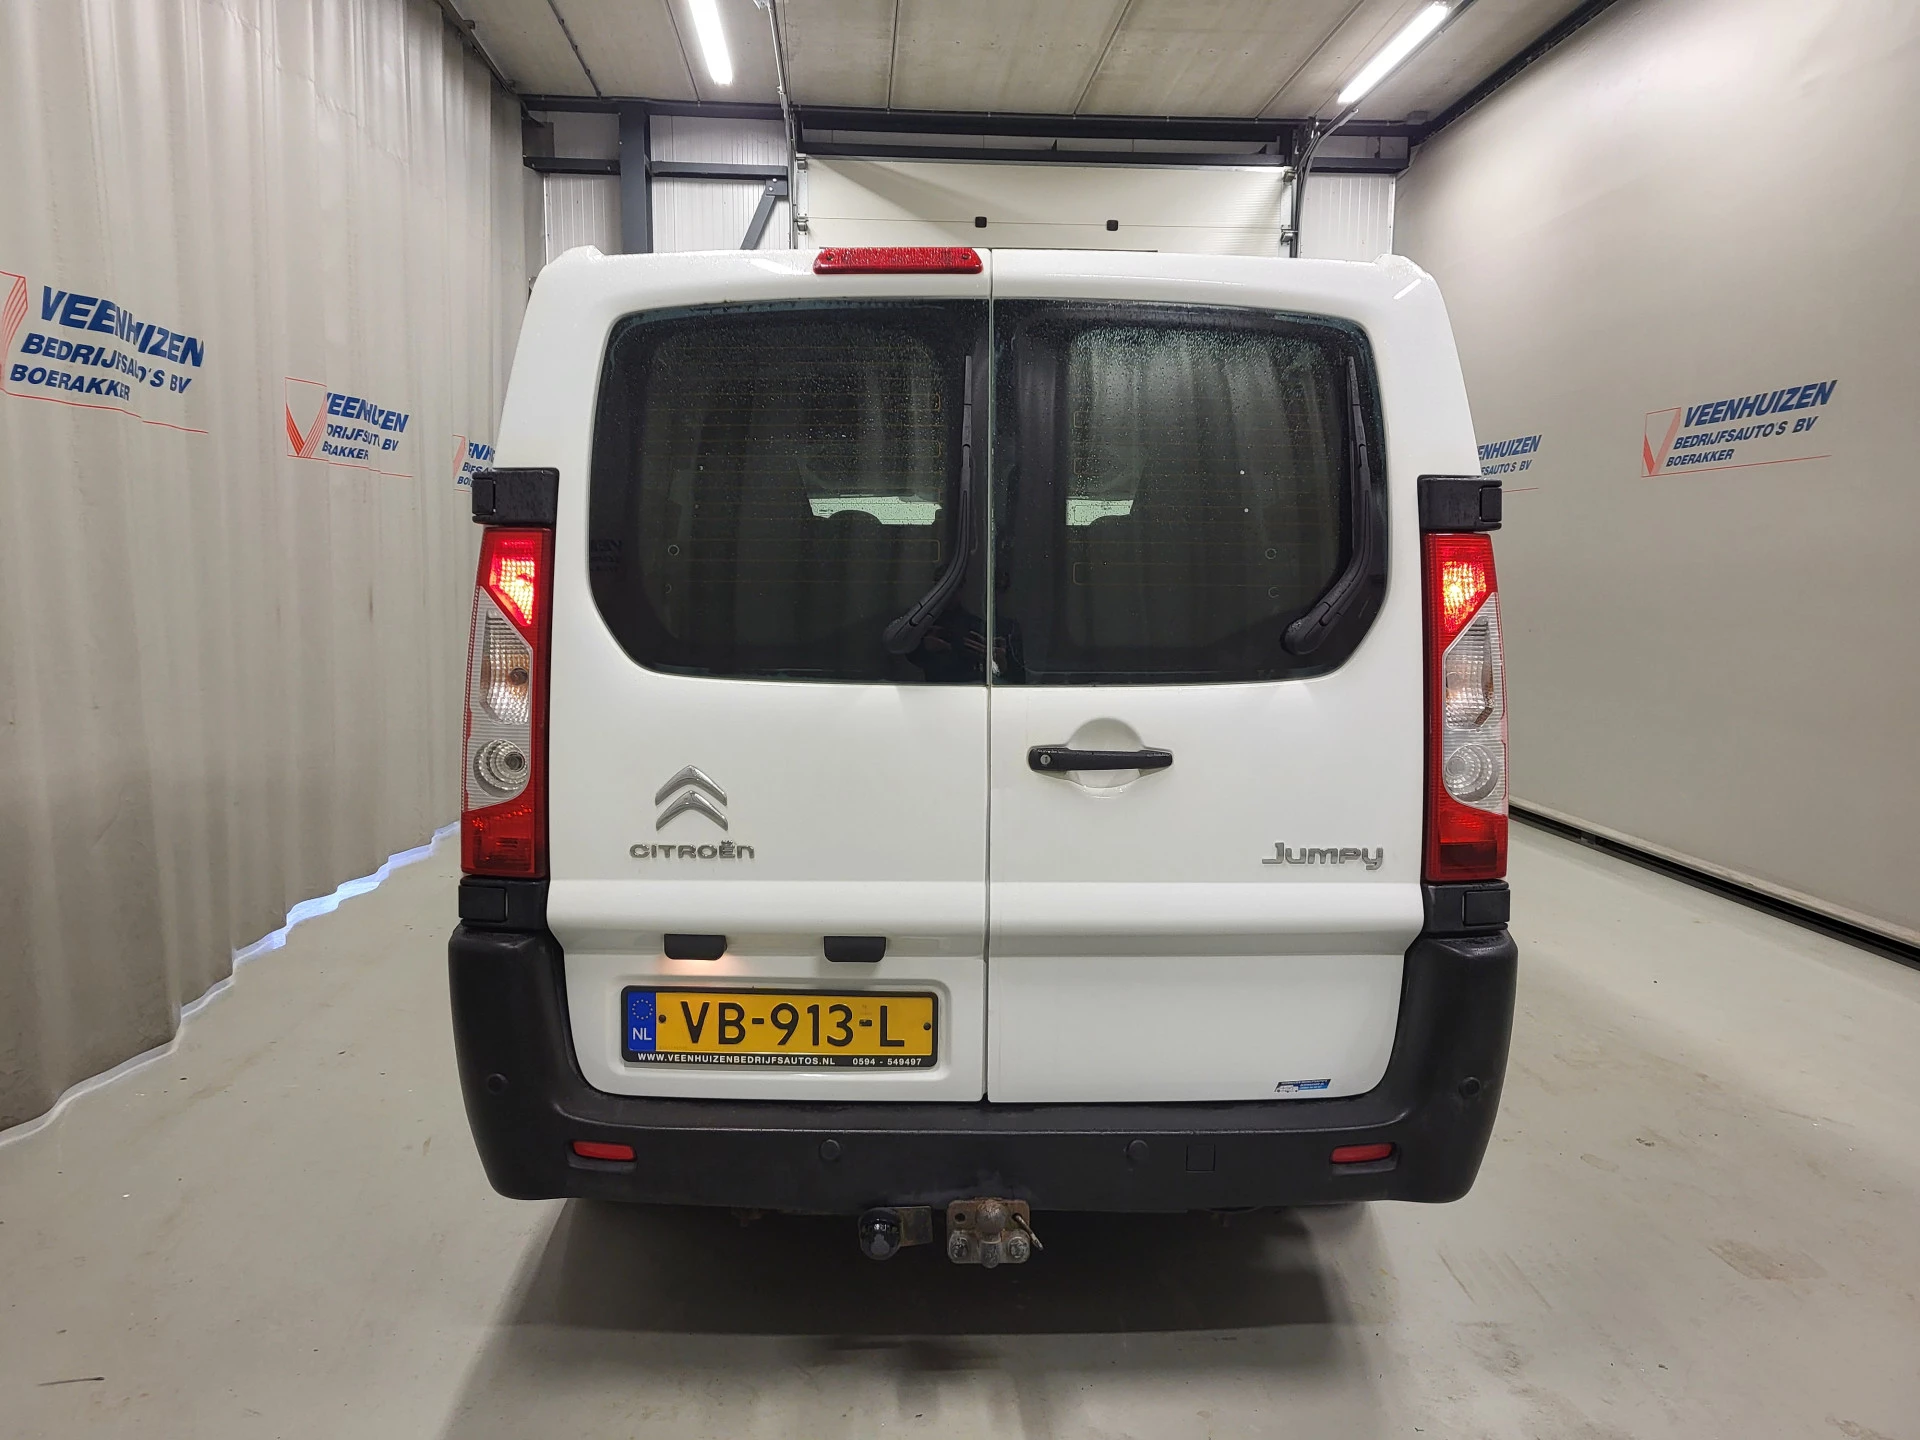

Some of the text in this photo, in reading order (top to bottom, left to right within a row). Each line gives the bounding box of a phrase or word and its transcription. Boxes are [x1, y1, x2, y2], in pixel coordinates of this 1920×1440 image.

[9, 364, 130, 401] BOERAKKER
[169, 374, 192, 394] BV
[1684, 380, 1838, 428] VEENHUIZEN
[1673, 416, 1819, 450] BEDRIJFSAUTO'S BV
[381, 438, 399, 452] BV
[1518, 459, 1533, 471] BV
[1666, 449, 1735, 467] BOERAKKER
[1261, 841, 1384, 871] Jumpy
[632, 1027, 653, 1041] NL
[680, 1001, 905, 1047] VB-913-L
[637, 1052, 836, 1066] WWW.VEENHUIZENBEDRIJFSAUTOS.NL
[852, 1057, 876, 1066] 0594
[887, 1058, 922, 1067] 549497
